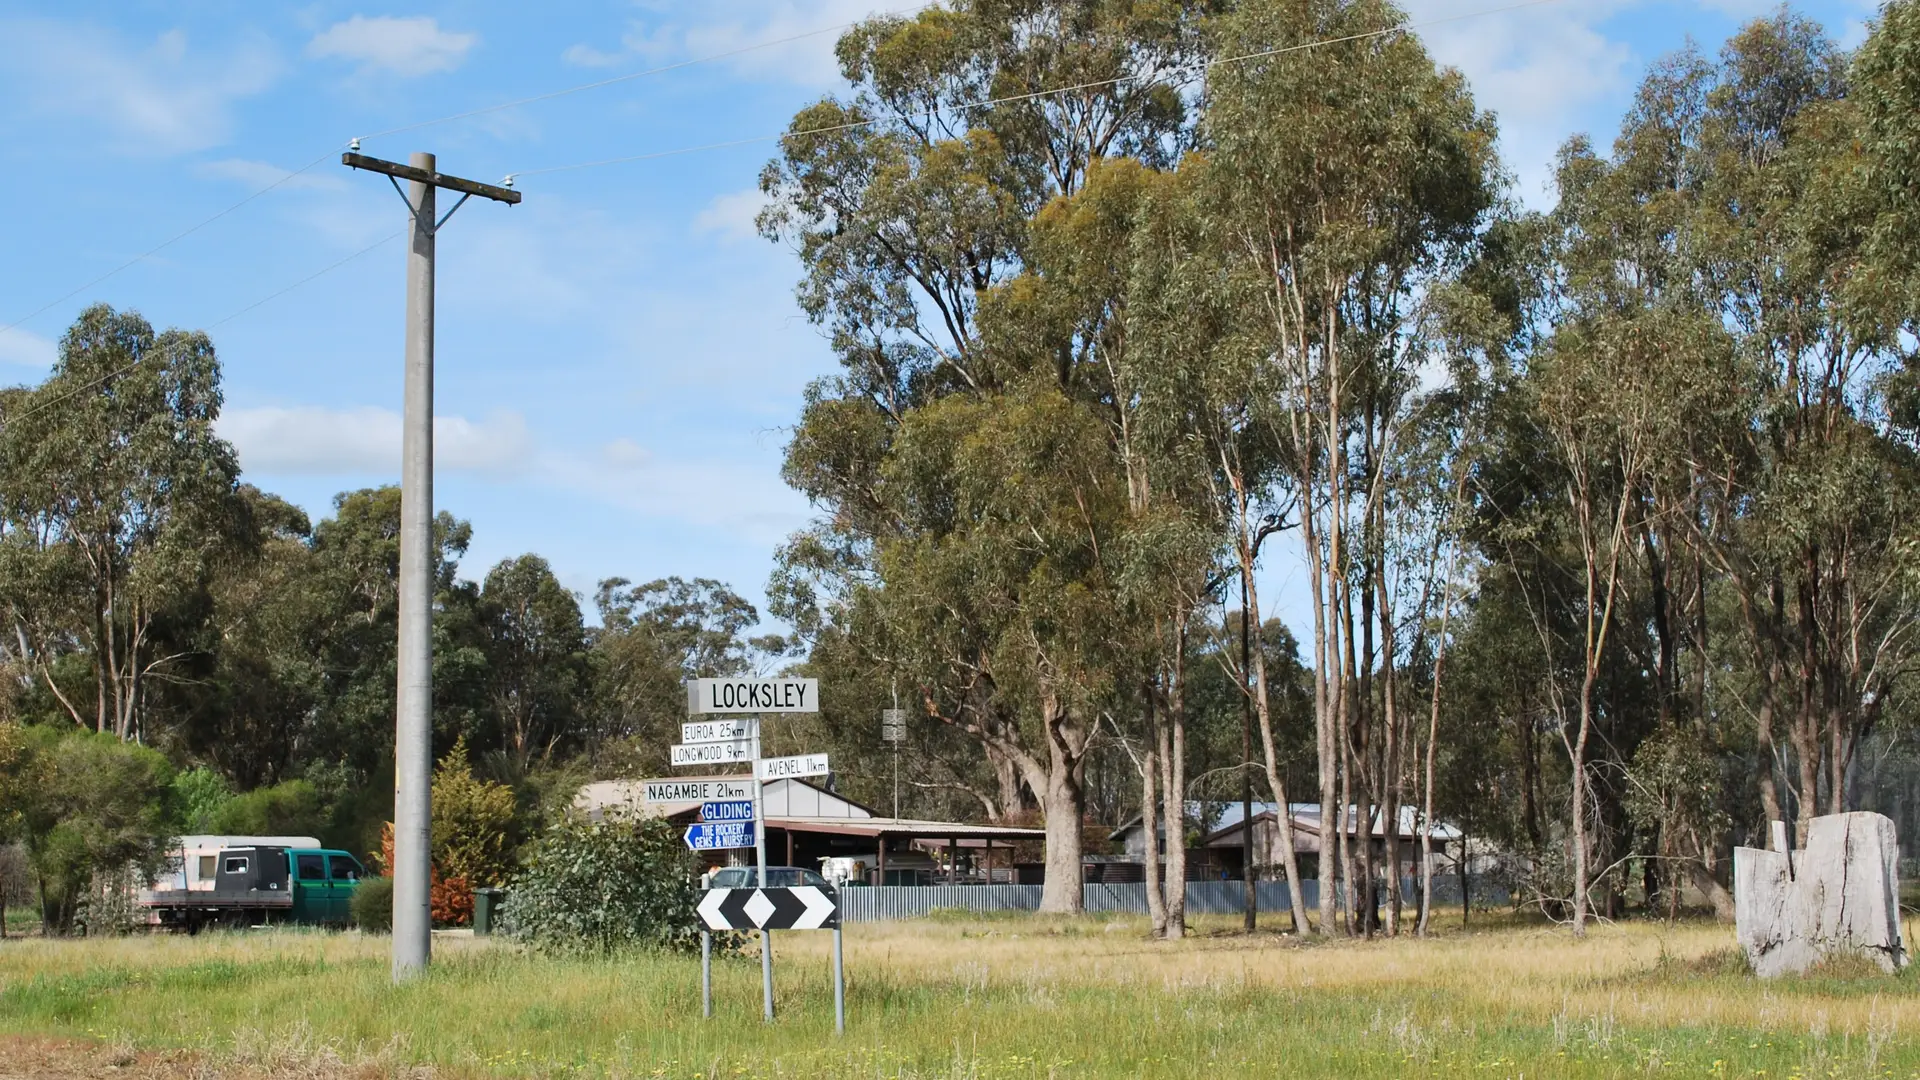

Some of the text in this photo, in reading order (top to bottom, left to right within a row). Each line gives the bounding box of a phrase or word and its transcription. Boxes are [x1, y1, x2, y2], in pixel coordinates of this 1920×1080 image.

[712, 683, 807, 708] LOCKSLEY
[685, 723, 744, 740] EUROA 25km
[674, 745, 745, 762] LONGWOOD 9km
[768, 758, 826, 776] AVENEL 11km
[648, 783, 744, 799] NAGAMBIE 21km
[705, 802, 751, 819] GLIDING
[702, 823, 745, 837] THE ROCKERY
[695, 834, 753, 848] GEMS & NURSERY
